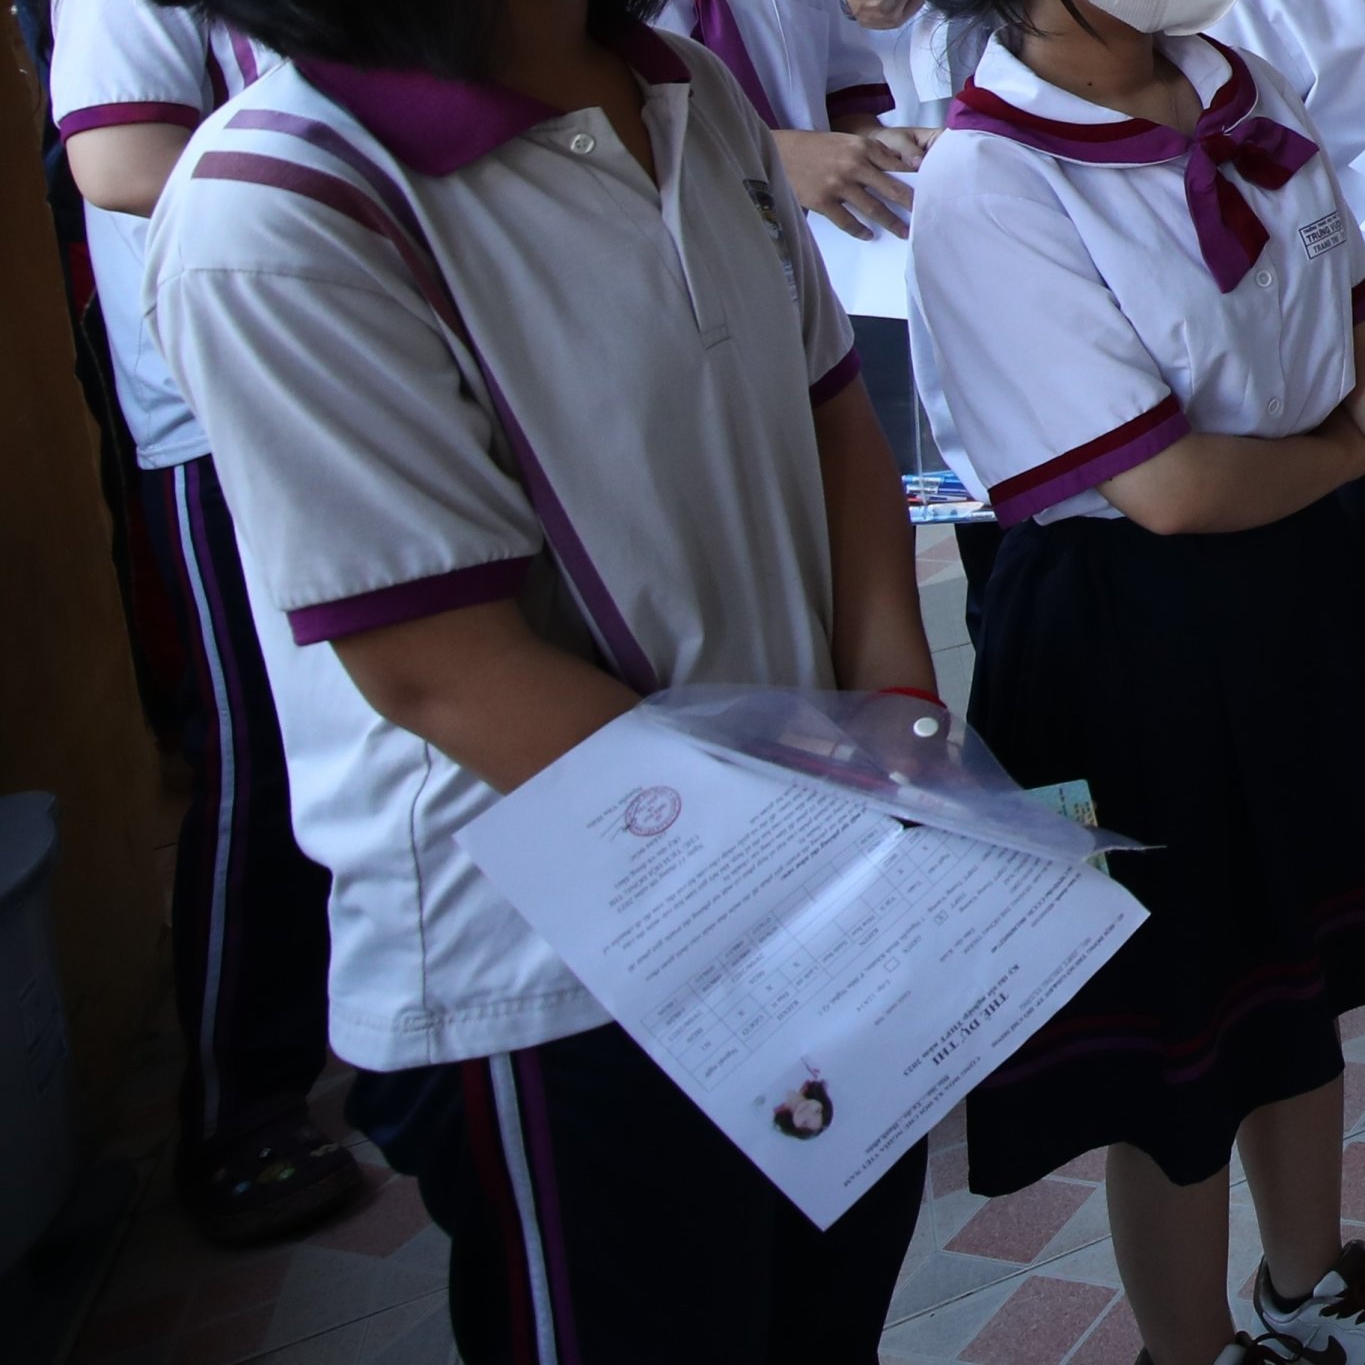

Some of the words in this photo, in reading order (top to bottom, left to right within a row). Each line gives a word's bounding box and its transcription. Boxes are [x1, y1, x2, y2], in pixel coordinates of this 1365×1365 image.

[978, 989, 1012, 1024] THẺ
[954, 1015, 982, 1044] DỰ
[930, 1038, 959, 1067] THI
